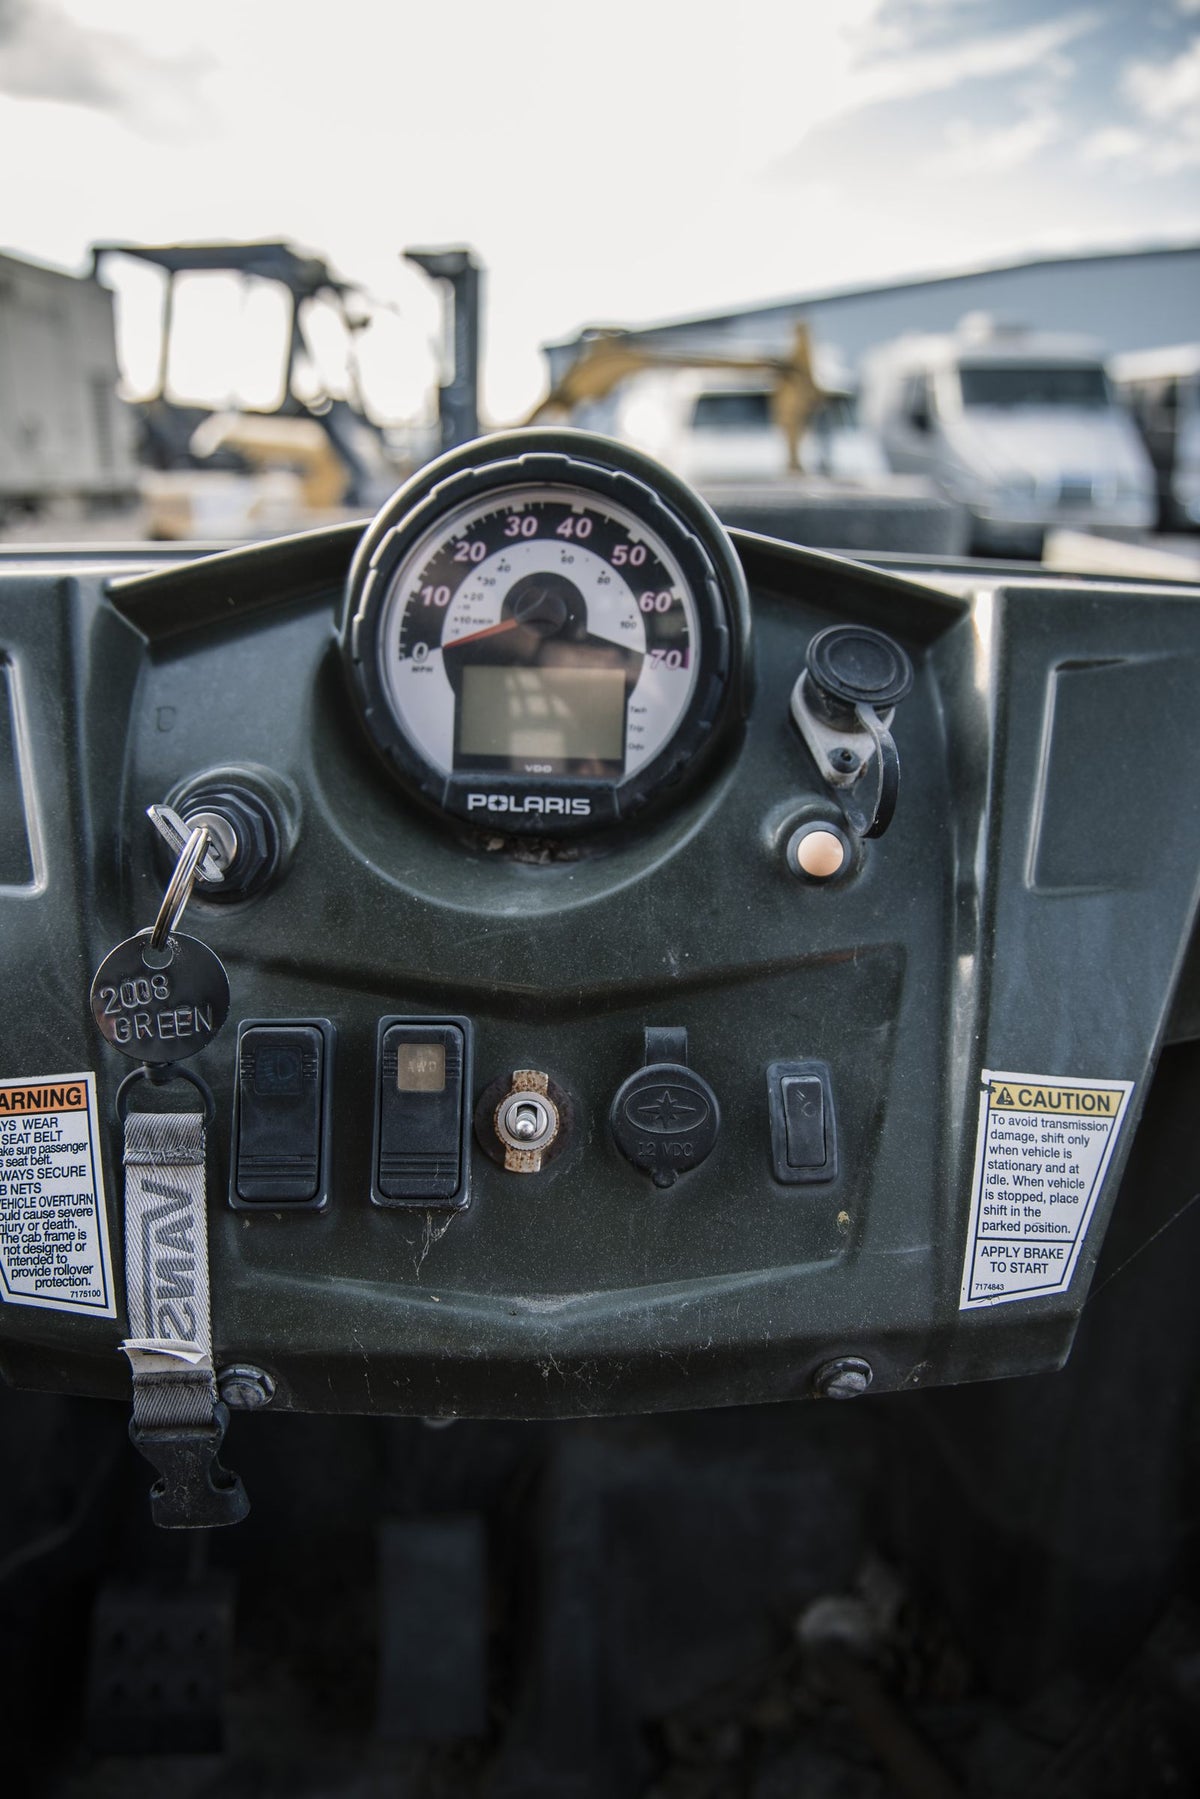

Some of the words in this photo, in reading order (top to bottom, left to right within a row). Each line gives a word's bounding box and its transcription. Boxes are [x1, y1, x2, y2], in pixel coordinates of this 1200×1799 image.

[504, 516, 538, 537] 30
[556, 517, 592, 538] 40
[454, 541, 486, 562] 20
[611, 545, 646, 565] 50
[421, 585, 451, 607] 10
[640, 591, 672, 612] 60
[412, 641, 429, 664] 0
[650, 649, 682, 671] 70
[525, 765, 552, 773] VDO
[467, 793, 591, 815] POLARIS
[100, 975, 169, 1014] 2008
[114, 1004, 212, 1043] GREEN
[407, 1060, 437, 1073] AWD
[1018, 1089, 1110, 1112] CAUTION
[0, 1120, 17, 1132] YS
[22, 1117, 58, 1130] WEAR
[991, 1114, 1005, 1125] To
[1008, 1116, 1038, 1128] avoid
[1041, 1118, 1108, 1132] transmission
[2, 1133, 31, 1145] SEAT
[34, 1130, 63, 1143] BELT
[990, 1129, 1038, 1144] damage,
[1041, 1133, 1064, 1144] shift
[1067, 1134, 1090, 1148] only
[16, 1145, 36, 1155] sure
[39, 1142, 88, 1156] passenger
[639, 1142, 656, 1156] 12
[662, 1142, 694, 1157] VDC
[988, 1144, 1018, 1156] when
[1021, 1146, 1060, 1158] vehicle
[1063, 1148, 1073, 1159] is
[6, 1156, 28, 1168] seat
[30, 1154, 52, 1166] belt.
[987, 1160, 1042, 1174] stationary
[1045, 1162, 1066, 1174] and
[1068, 1164, 1079, 1174] at
[0, 1169, 34, 1182] WAYS
[37, 1165, 87, 1180] SECURE
[10, 1183, 42, 1195] NETS
[986, 1174, 1009, 1186] idle.
[1012, 1175, 1044, 1187] When
[1047, 1177, 1085, 1189] vehicle
[0, 1197, 37, 1210] EHICLE
[39, 1194, 93, 1208] OVERTURN
[985, 1189, 994, 1200] is
[997, 1190, 1046, 1204] stopped,
[1049, 1193, 1079, 1205] place
[23, 1210, 55, 1220] cause
[58, 1207, 93, 1218] severe
[983, 1205, 1007, 1216] shift
[1010, 1205, 1020, 1216] in
[1023, 1206, 1041, 1217] the
[28, 1222, 40, 1231] or
[42, 1218, 77, 1230] death.
[982, 1220, 1021, 1233] parked
[1024, 1222, 1071, 1234] position.
[0, 1232, 19, 1244] The
[21, 1231, 41, 1242] cab
[44, 1230, 75, 1241] frame
[78, 1229, 87, 1240] is
[3, 1244, 20, 1255] not
[22, 1241, 72, 1255] designed
[75, 1242, 87, 1251] or
[981, 1246, 1020, 1258] APPLY
[1024, 1247, 1064, 1259] BRAKE
[7, 1254, 54, 1266] intended
[56, 1253, 68, 1264] to
[11, 1266, 51, 1280] provide
[54, 1264, 94, 1276] rollover
[990, 1261, 1006, 1273] TO
[1010, 1263, 1049, 1274] START
[35, 1275, 91, 1290] protection.
[975, 1283, 1004, 1291] 7174843
[70, 1290, 101, 1298] 7175100
